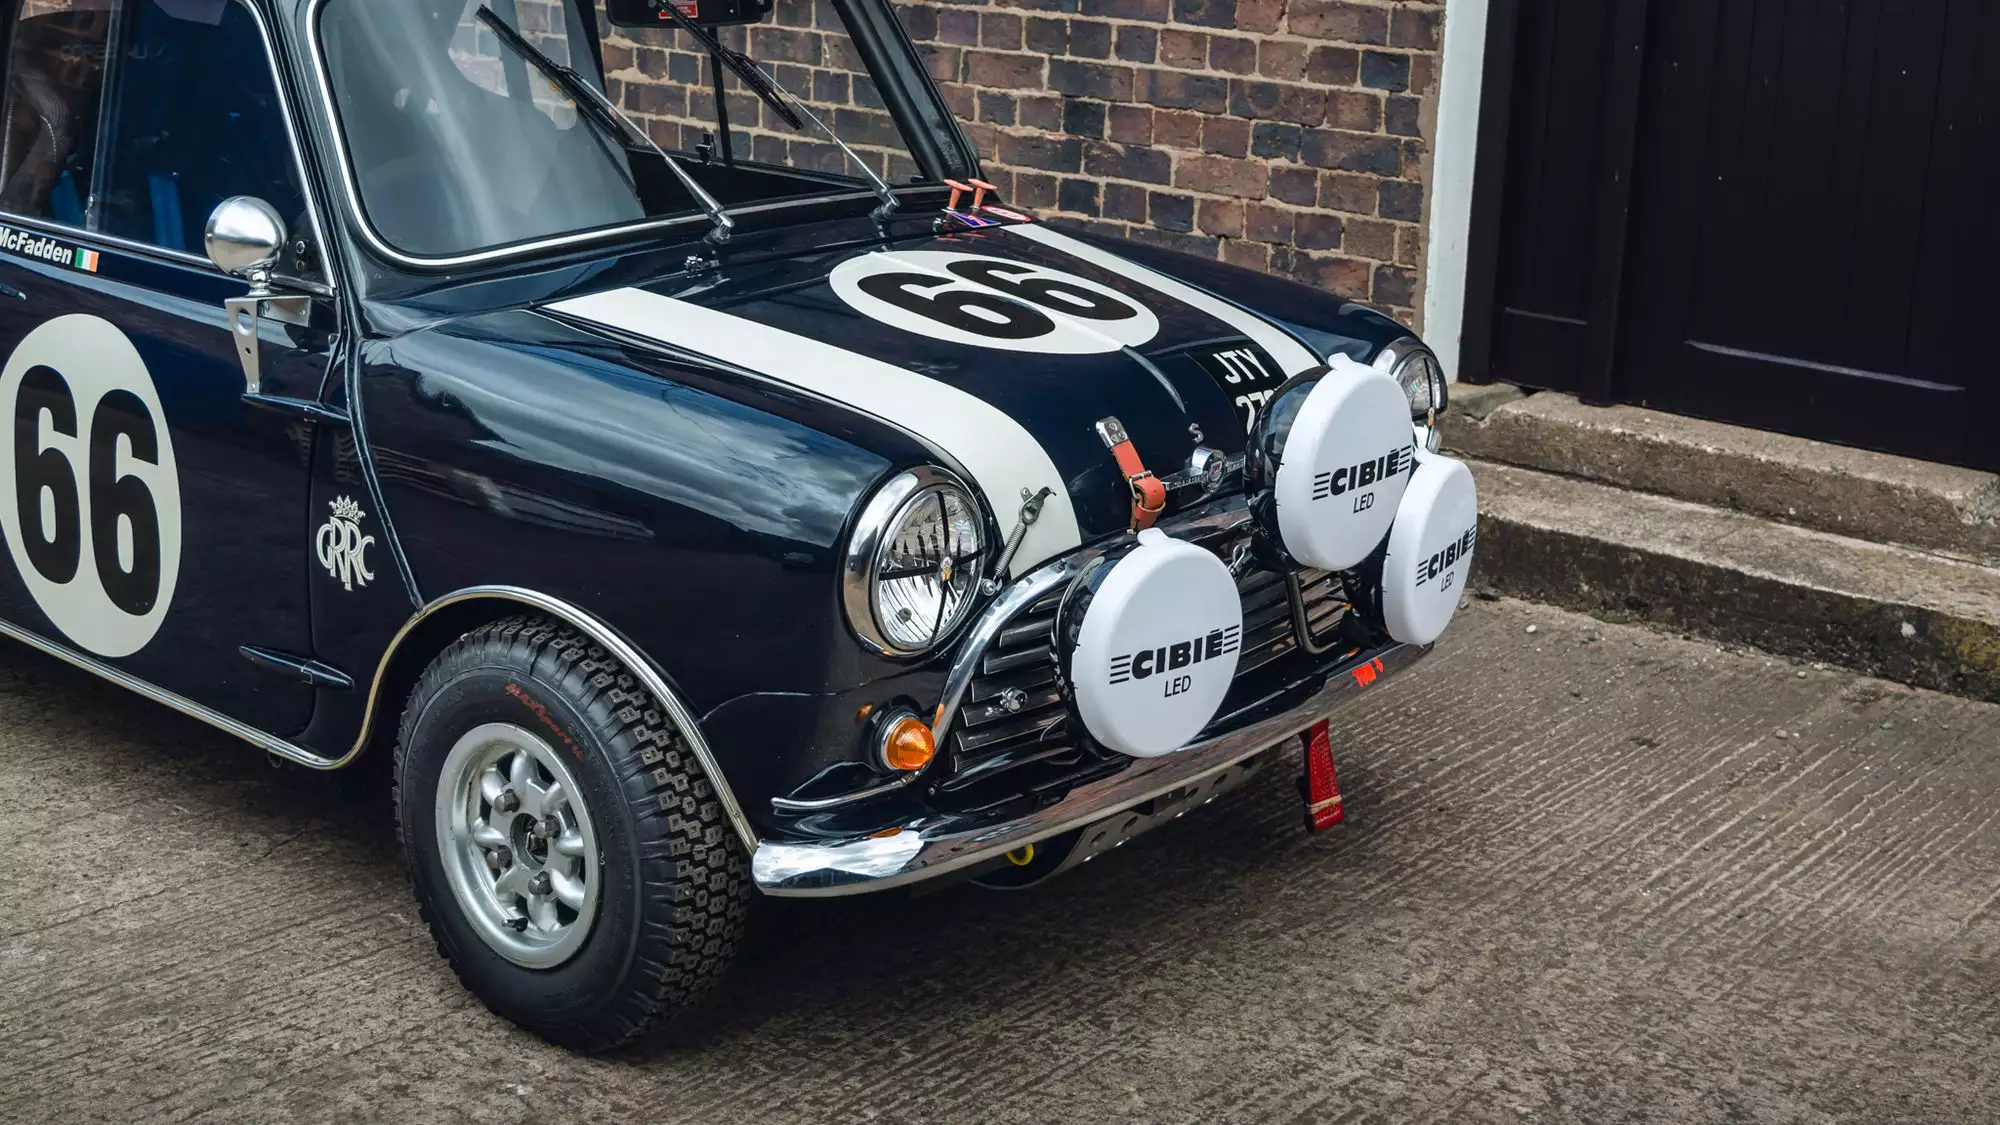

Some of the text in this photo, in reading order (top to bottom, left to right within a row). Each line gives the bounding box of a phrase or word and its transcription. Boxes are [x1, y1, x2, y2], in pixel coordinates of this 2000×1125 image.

[0, 226, 73, 265] McFadden
[857, 259, 1138, 340] 66
[1212, 347, 1270, 384] JTY
[14, 364, 161, 617] 66
[1353, 492, 1375, 514] LED
[1441, 571, 1455, 593] LED
[1164, 675, 1192, 698] LED
